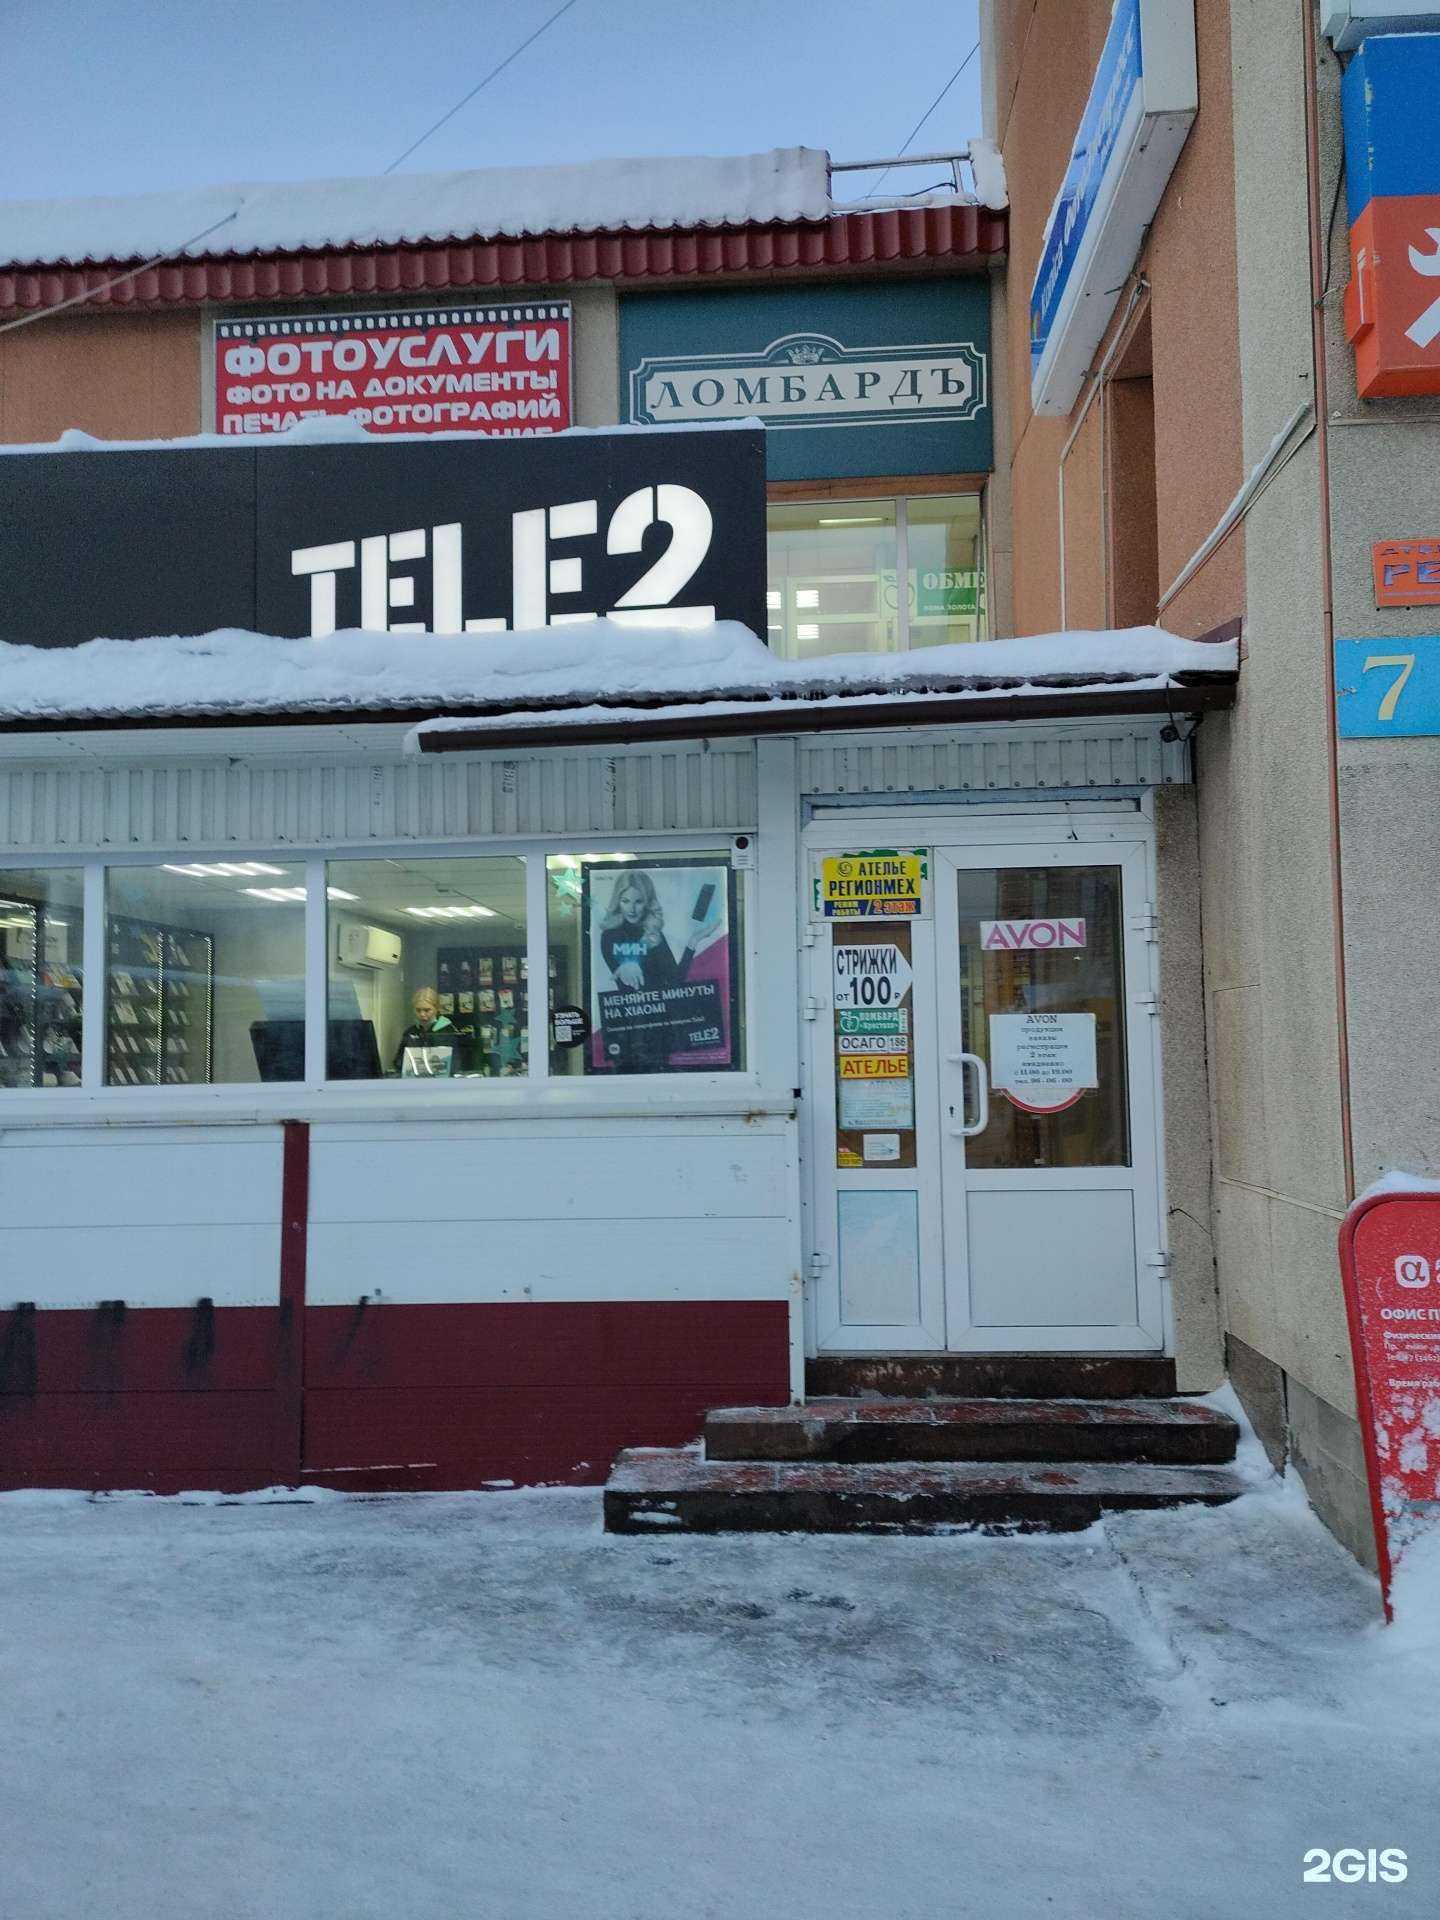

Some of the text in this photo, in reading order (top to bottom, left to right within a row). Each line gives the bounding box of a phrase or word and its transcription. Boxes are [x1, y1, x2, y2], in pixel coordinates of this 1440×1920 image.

[224, 328, 560, 377] ФОТОУСЛУГИ
[226, 370, 558, 405] ФОТО НА ДОКУМЕНТЫ
[651, 367, 966, 409] ЛОМБАРДЪ
[223, 393, 561, 434] ПЕЧА ФОТОГРАФИЙ
[291, 484, 716, 639] TELE2
[1362, 654, 1415, 720] 7
[859, 861, 907, 876] АТЕЛЬЕ
[829, 879, 915, 896] РЕГИОНМЕХ
[873, 900, 882, 914] 2
[986, 921, 1085, 949] AVON
[613, 943, 648, 956] МИН
[836, 948, 897, 975] СТРИЖКИ
[604, 985, 714, 1006] МЕНЯЙТЕ МИНУТЫ
[850, 976, 891, 1005] 100
[605, 1002, 666, 1019] НА XIAOMI
[1026, 1015, 1057, 1024] AVON
[688, 1027, 719, 1041] TELE2
[841, 1037, 886, 1049] ОСАГО
[842, 1058, 906, 1075] АТЕЛЬЕ
[1380, 1308, 1426, 1320] ОФИС
